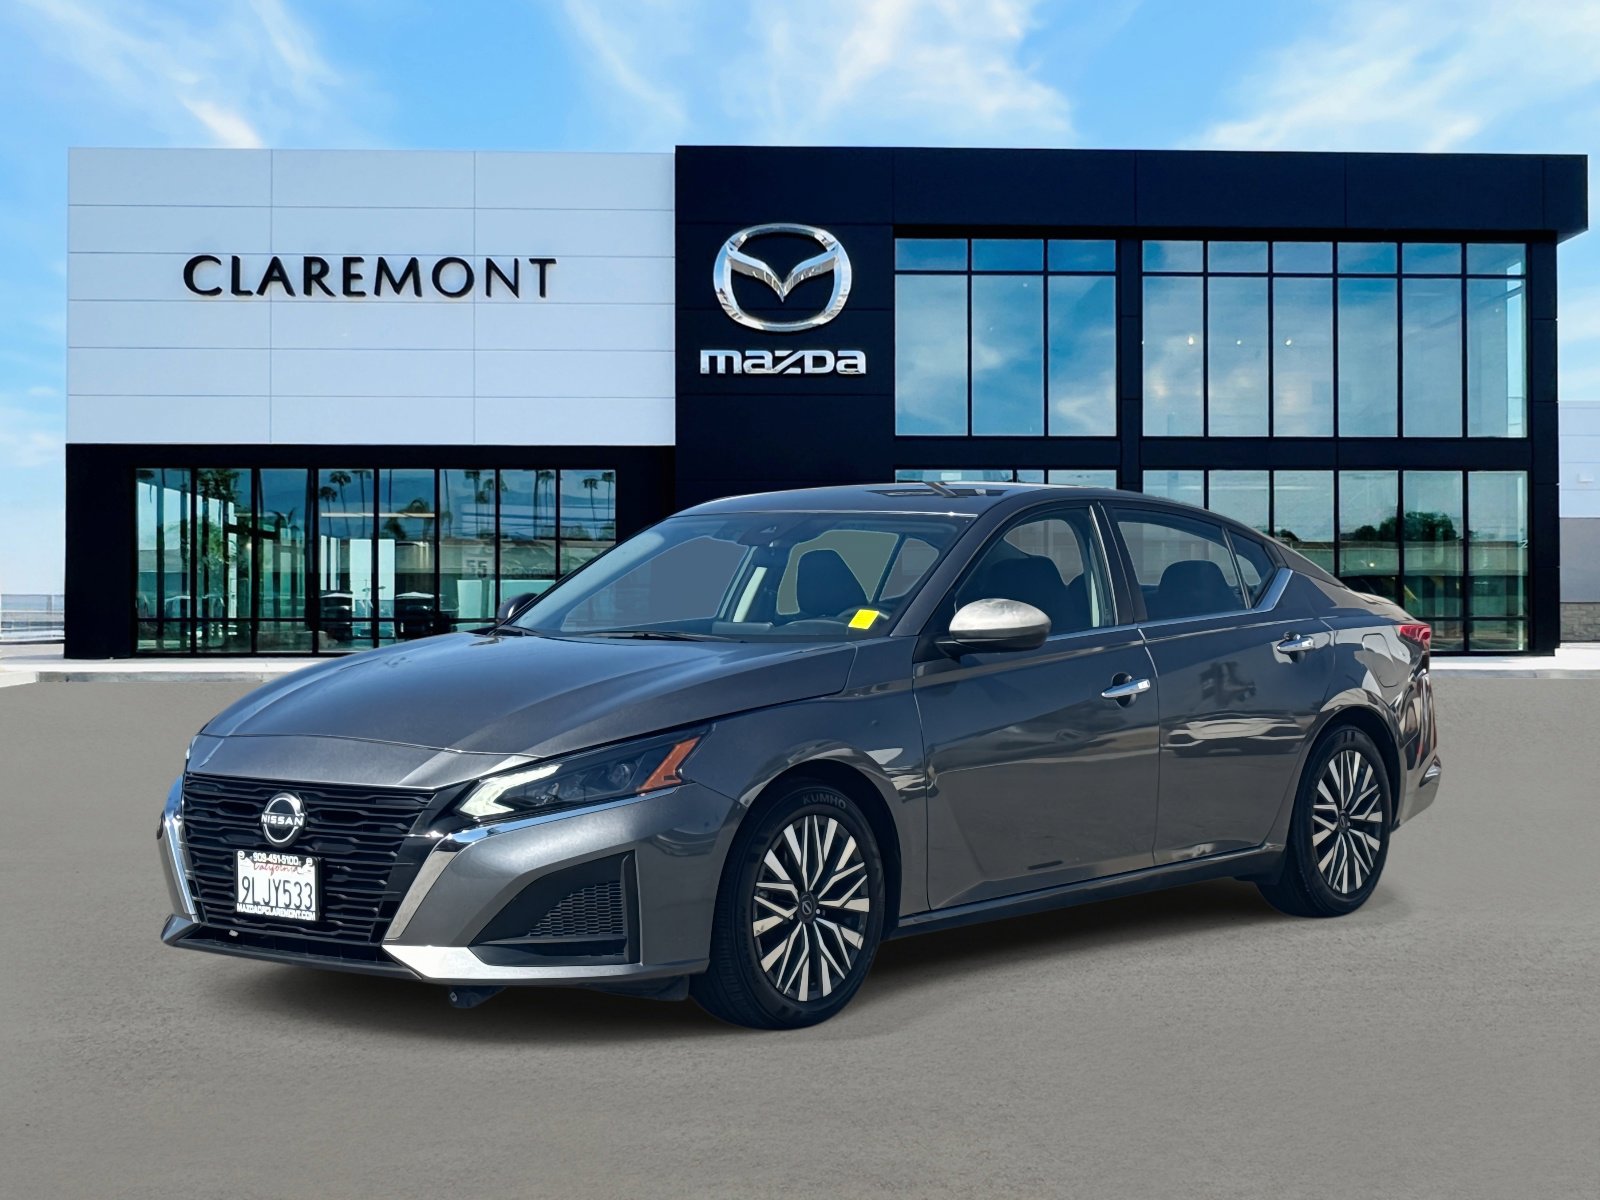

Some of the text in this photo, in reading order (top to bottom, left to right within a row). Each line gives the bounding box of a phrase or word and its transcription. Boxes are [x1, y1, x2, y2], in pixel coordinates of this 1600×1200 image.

[183, 254, 557, 298] CLAREMONT
[803, 793, 847, 809] KUMHO
[261, 814, 304, 826] NISSAN
[242, 876, 313, 911] 9LJY533
